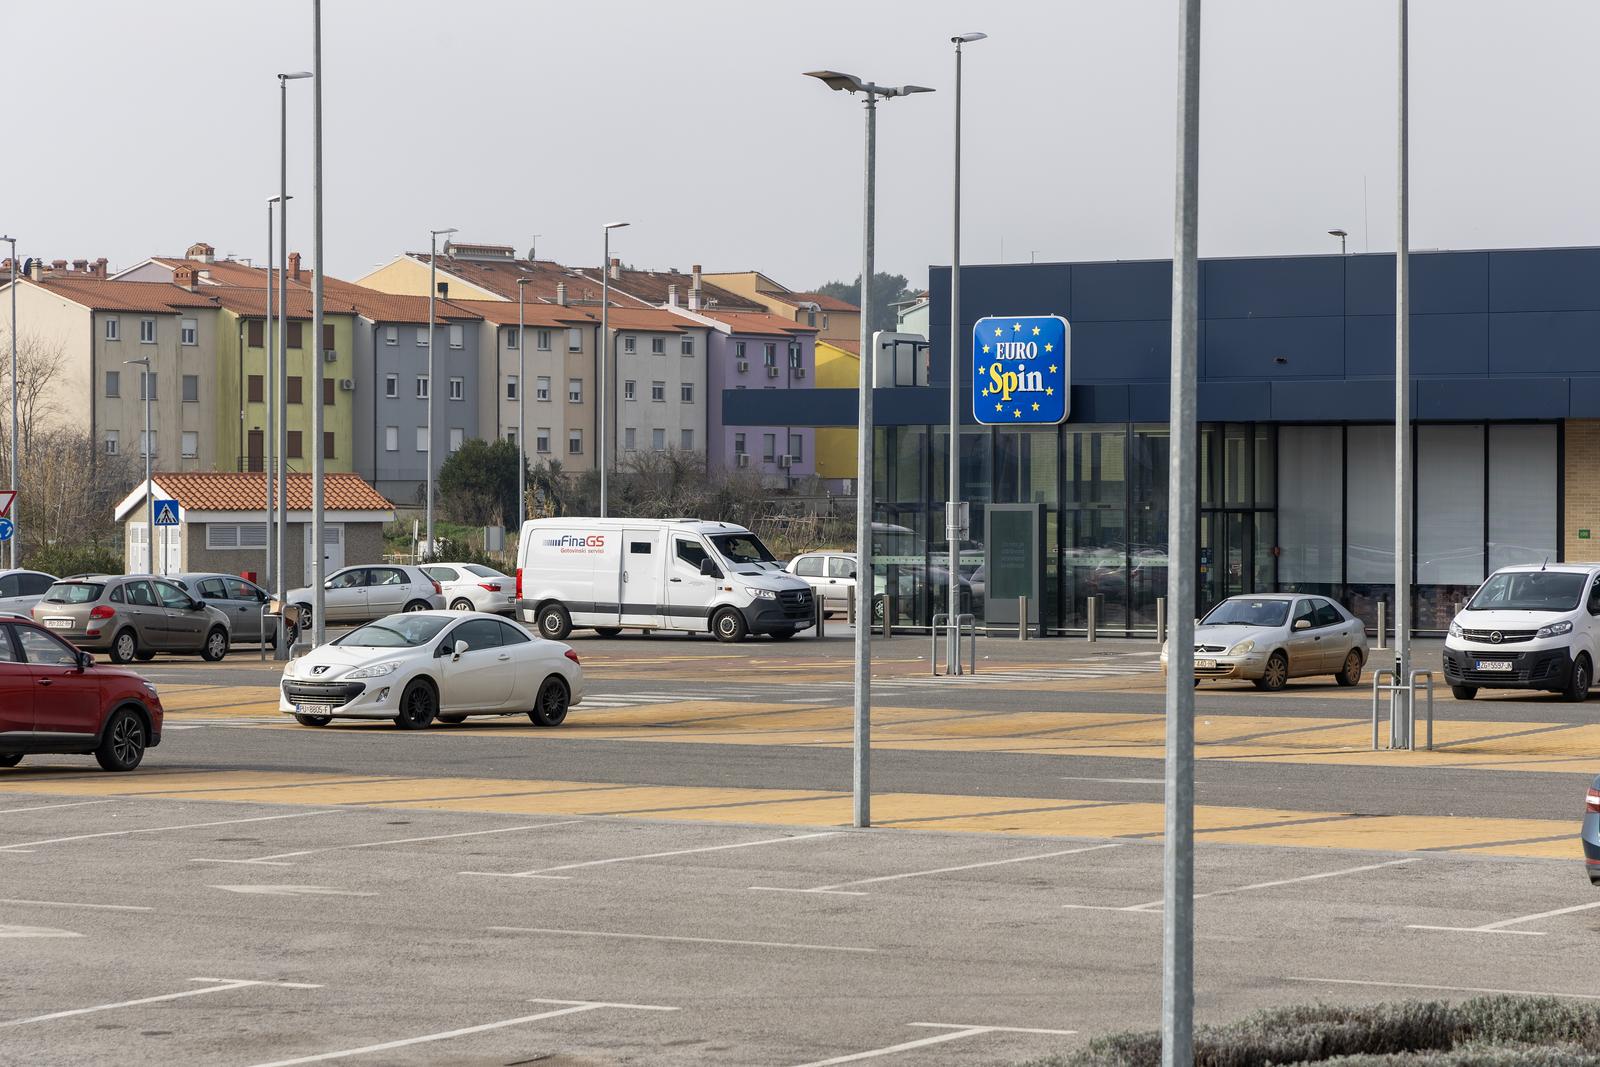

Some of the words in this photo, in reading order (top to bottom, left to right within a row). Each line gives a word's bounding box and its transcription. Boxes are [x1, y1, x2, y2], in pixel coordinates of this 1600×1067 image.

[996, 341, 1038, 360] EURO
[989, 362, 1045, 401] Spin
[561, 535, 605, 547] FinaGS
